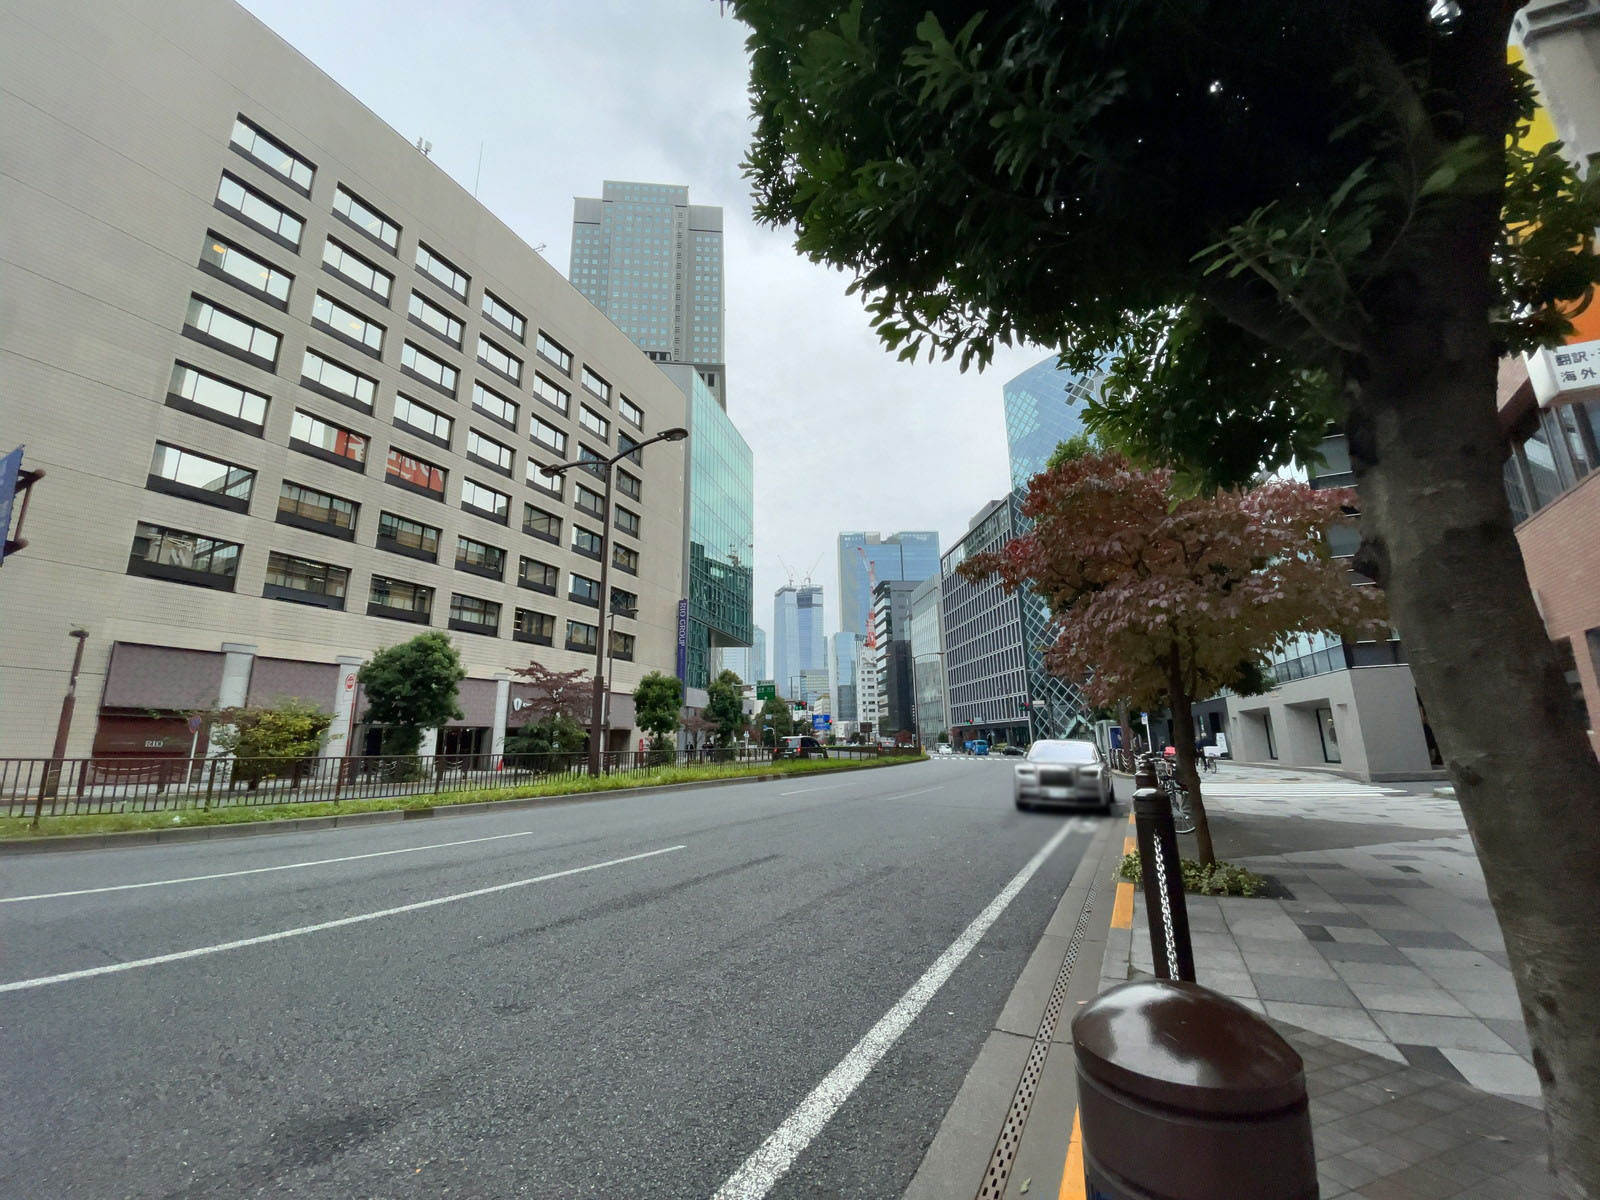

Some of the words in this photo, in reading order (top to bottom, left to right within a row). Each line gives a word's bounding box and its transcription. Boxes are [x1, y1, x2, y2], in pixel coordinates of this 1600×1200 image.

[1556, 348, 1600, 367] 翻訳・
[1560, 367, 1597, 382] 海外
[144, 740, 164, 748] RIO
